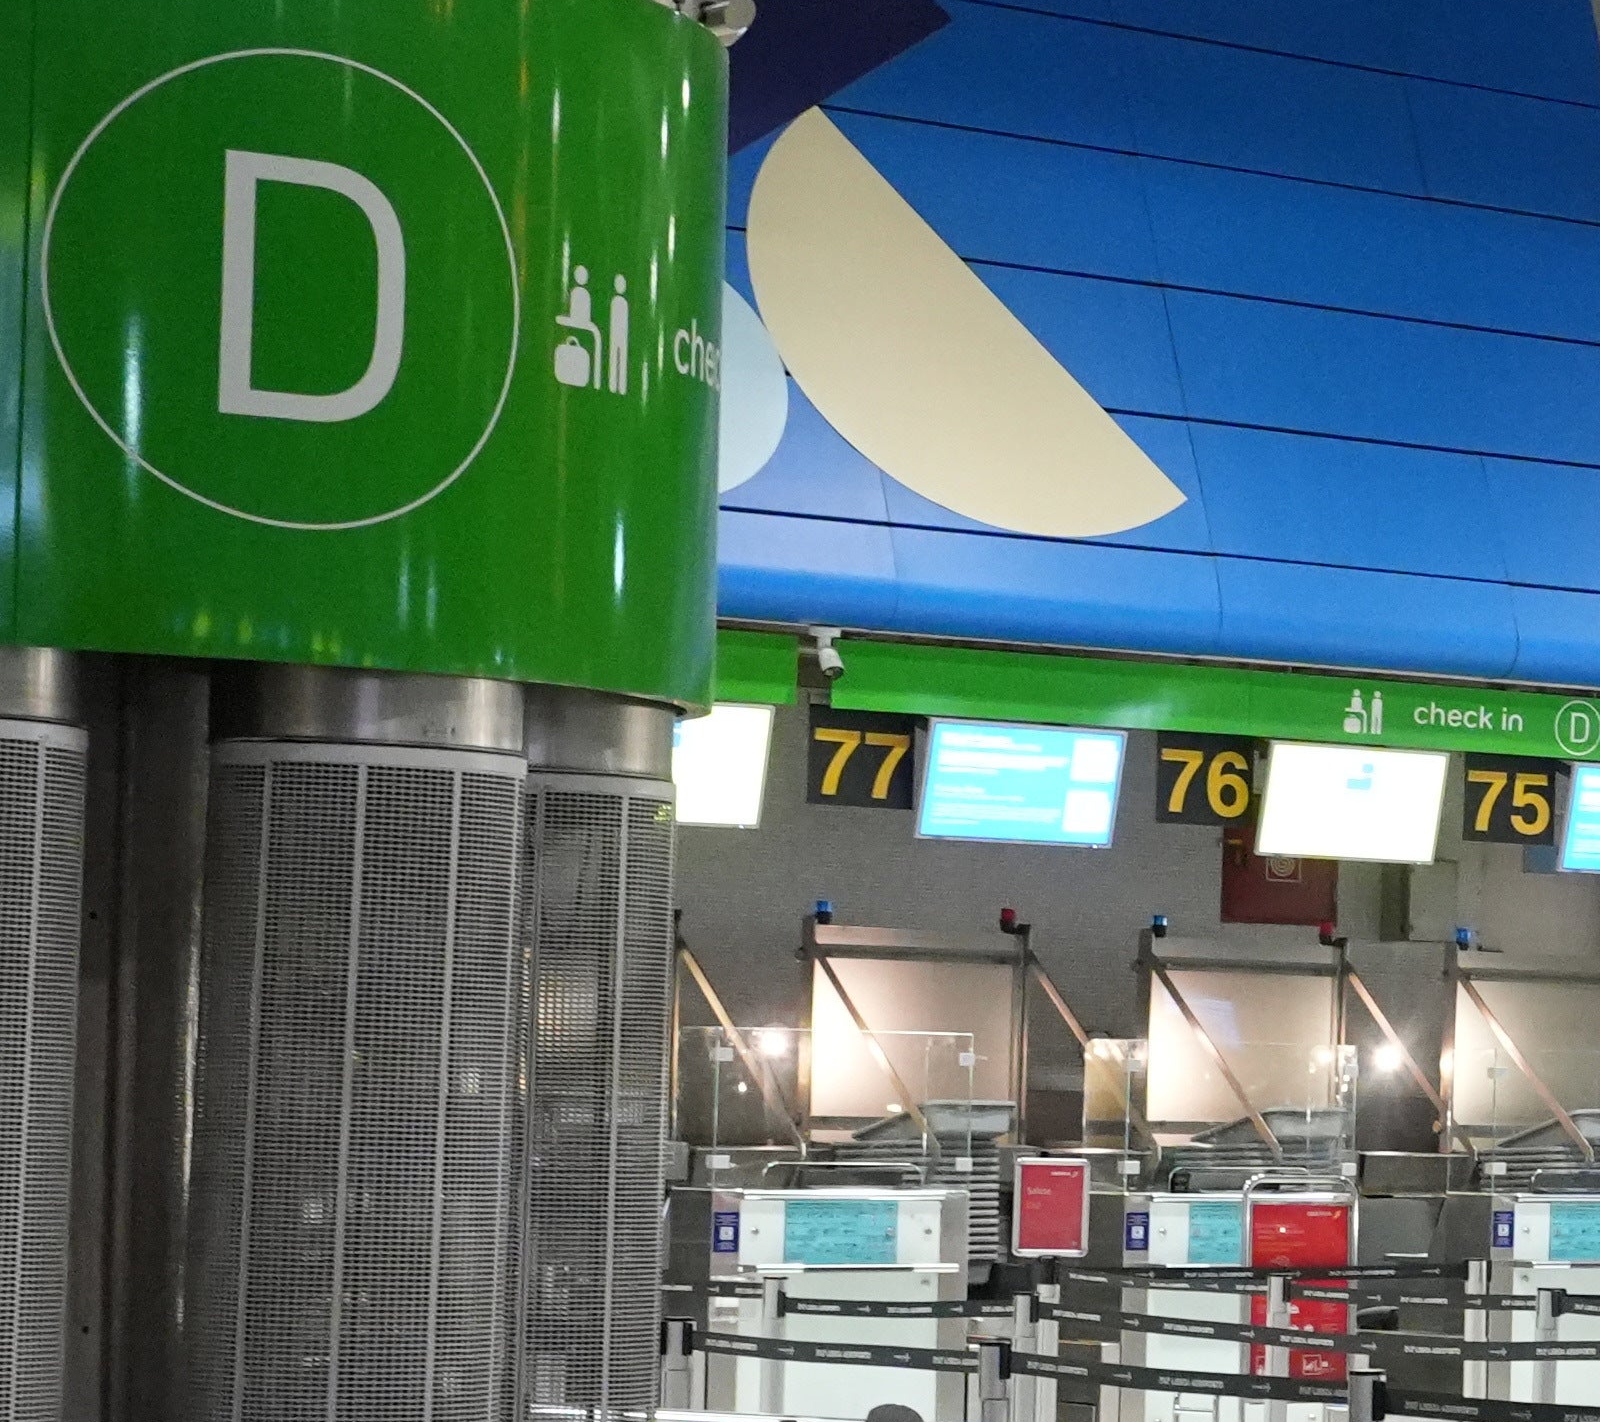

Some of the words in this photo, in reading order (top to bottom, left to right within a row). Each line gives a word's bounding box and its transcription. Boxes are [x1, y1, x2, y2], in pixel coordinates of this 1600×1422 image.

[219, 149, 406, 423] D
[1413, 700, 1495, 731] check
[1500, 705, 1524, 733] in
[1569, 711, 1591, 744] D
[812, 728, 910, 800] 77
[1161, 748, 1250, 818] 76
[1467, 769, 1551, 836] 75
